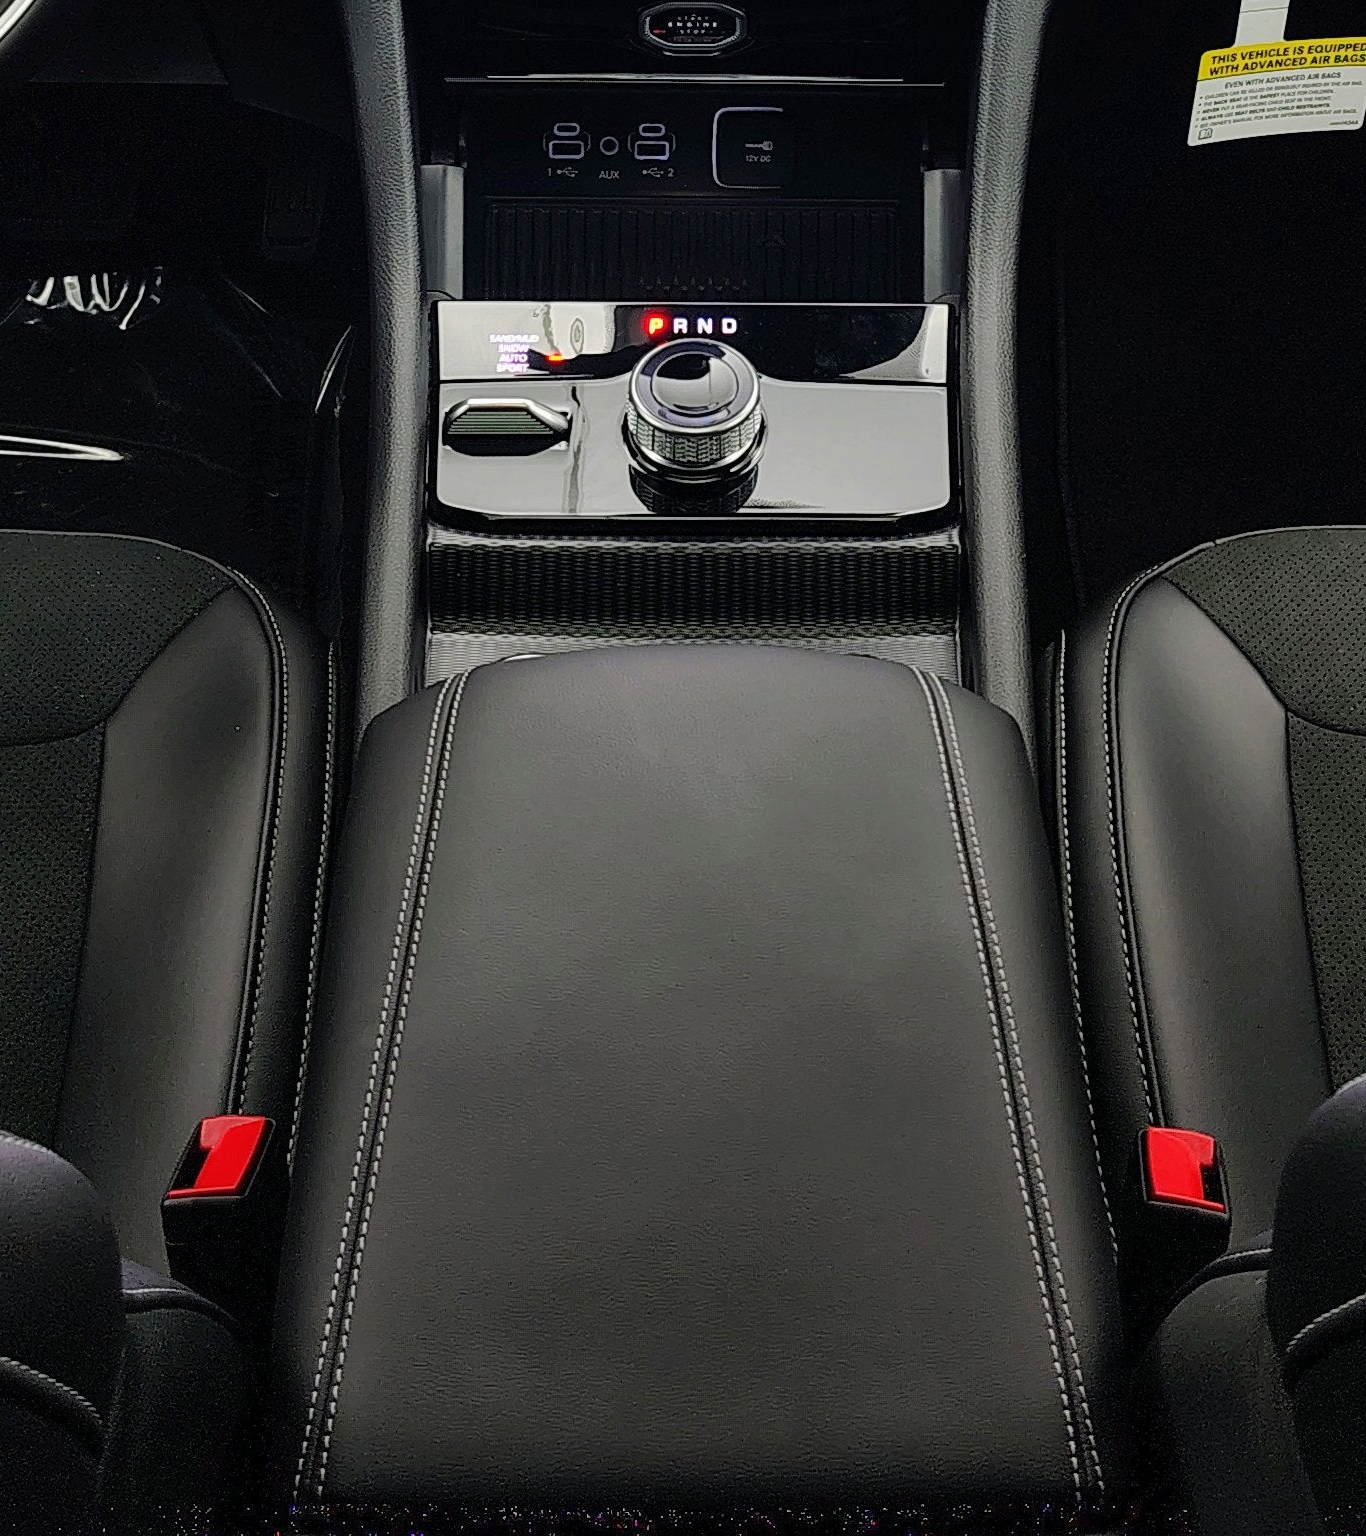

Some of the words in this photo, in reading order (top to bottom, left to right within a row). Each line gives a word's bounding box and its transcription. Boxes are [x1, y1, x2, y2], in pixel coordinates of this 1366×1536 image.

[1211, 53, 1238, 65] THIS
[1240, 47, 1290, 62] VEHICLE
[1292, 46, 1304, 56] IS
[1209, 65, 1239, 77] WITH
[1241, 57, 1307, 72] ADVANCED
[1309, 56, 1329, 65] AIR
[1334, 54, 1366, 64] BAGS
[1245, 78, 1264, 86] WITH
[1266, 74, 1306, 84] ADVANCED
[598, 170, 620, 180] AUX
[667, 168, 675, 178] 2
[648, 317, 665, 335] P
[673, 317, 688, 334] R
[696, 317, 713, 334] N
[721, 317, 738, 334] D
[498, 353, 528, 363] AUTO
